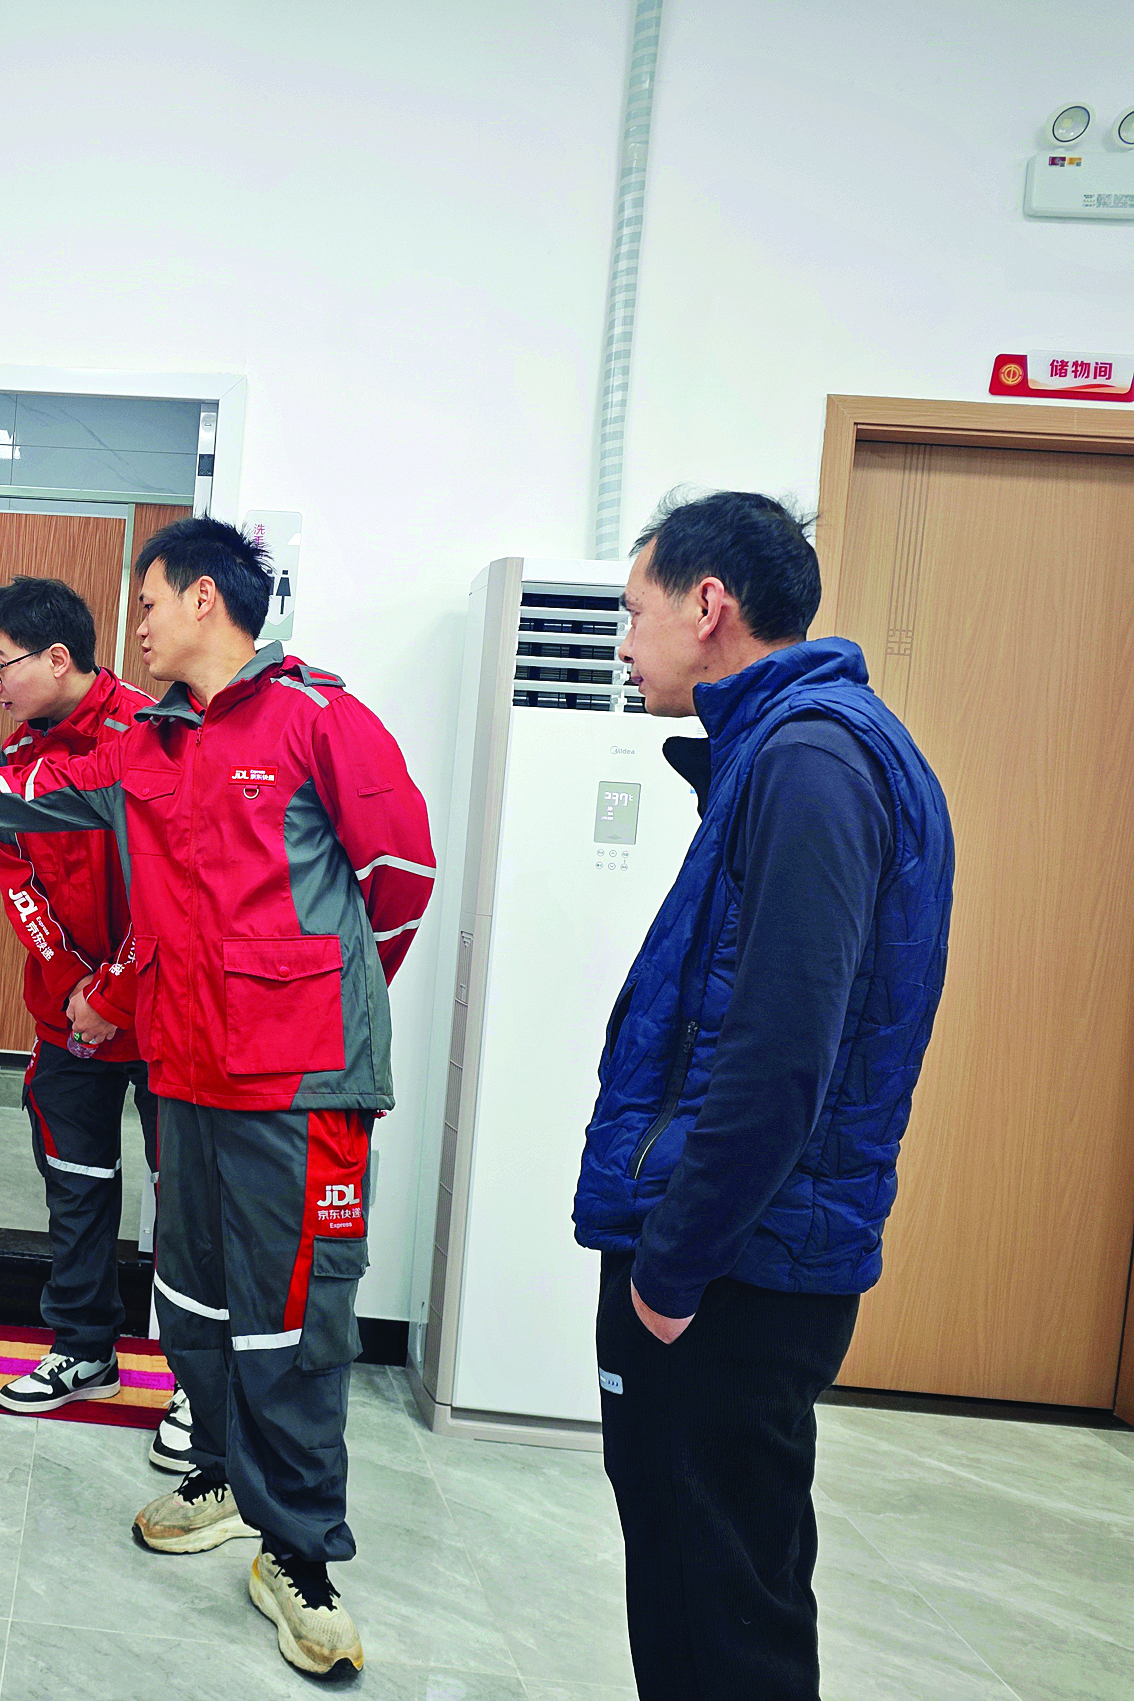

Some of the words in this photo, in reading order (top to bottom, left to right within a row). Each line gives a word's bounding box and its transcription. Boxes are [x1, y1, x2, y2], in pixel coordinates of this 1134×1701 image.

[1049, 359, 1114, 382] 储物间
[253, 523, 266, 558] 洗手
[232, 770, 249, 780] JDL
[8, 888, 38, 923] JDL
[25, 920, 55, 961] 京东快递
[316, 1184, 360, 1207] JDL
[317, 1207, 362, 1221] 京东快递
[329, 1221, 353, 1229] Express
